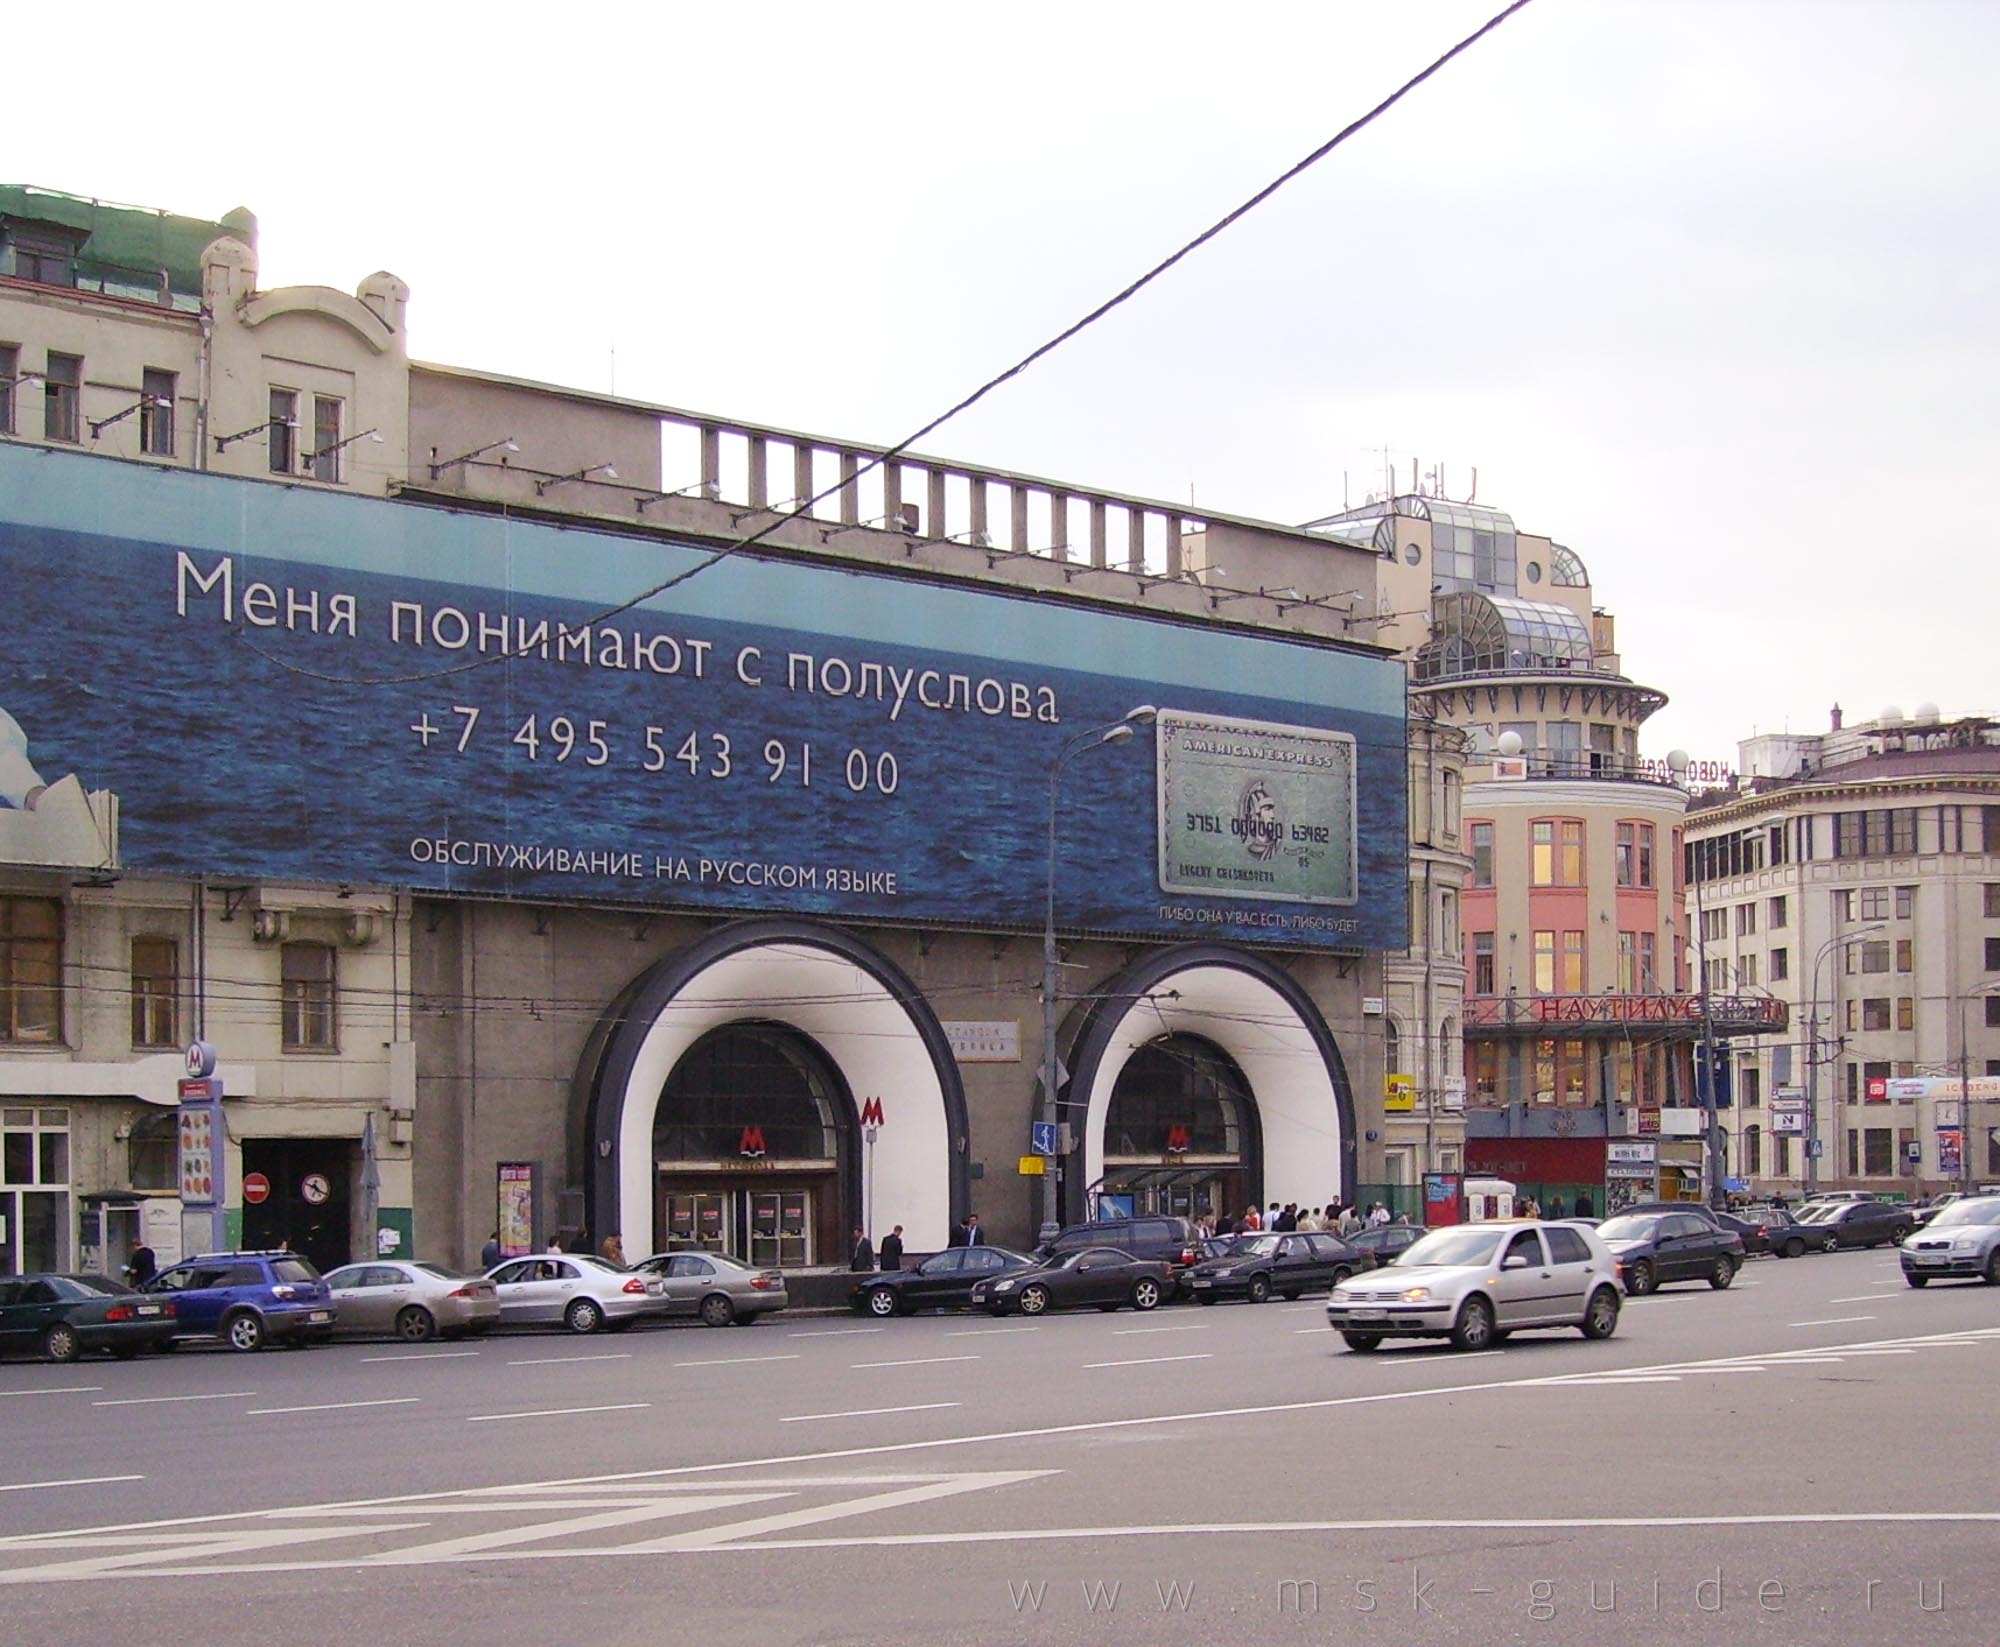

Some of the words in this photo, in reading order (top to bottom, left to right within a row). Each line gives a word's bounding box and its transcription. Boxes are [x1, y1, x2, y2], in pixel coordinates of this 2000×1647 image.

[177, 551, 356, 638] Меня
[391, 601, 712, 679] понимают
[736, 646, 762, 686] с
[787, 653, 1060, 723] полуслова
[410, 706, 480, 754] +7
[512, 713, 609, 767] 495
[643, 726, 732, 779] 543
[763, 739, 810, 788] 91
[845, 748, 899, 795] 00
[1183, 739, 1265, 760] AMERICAN
[1266, 749, 1333, 768] EXPRESS
[1186, 812, 1222, 834] 3751
[410, 837, 642, 879] ОБСЛУЖИВАНИЕ
[654, 855, 693, 884] НА
[699, 859, 817, 890] РУССКОМ
[824, 868, 898, 896] ЯЗЫКЕ
[1158, 905, 1194, 922] ЛИБО
[1196, 908, 1223, 923] ОНА
[1225, 910, 1233, 924] У
[1235, 912, 1259, 926] ВАС
[1292, 915, 1325, 930] ЛИБО
[861, 1096, 884, 1126] М
[739, 1125, 766, 1152] М
